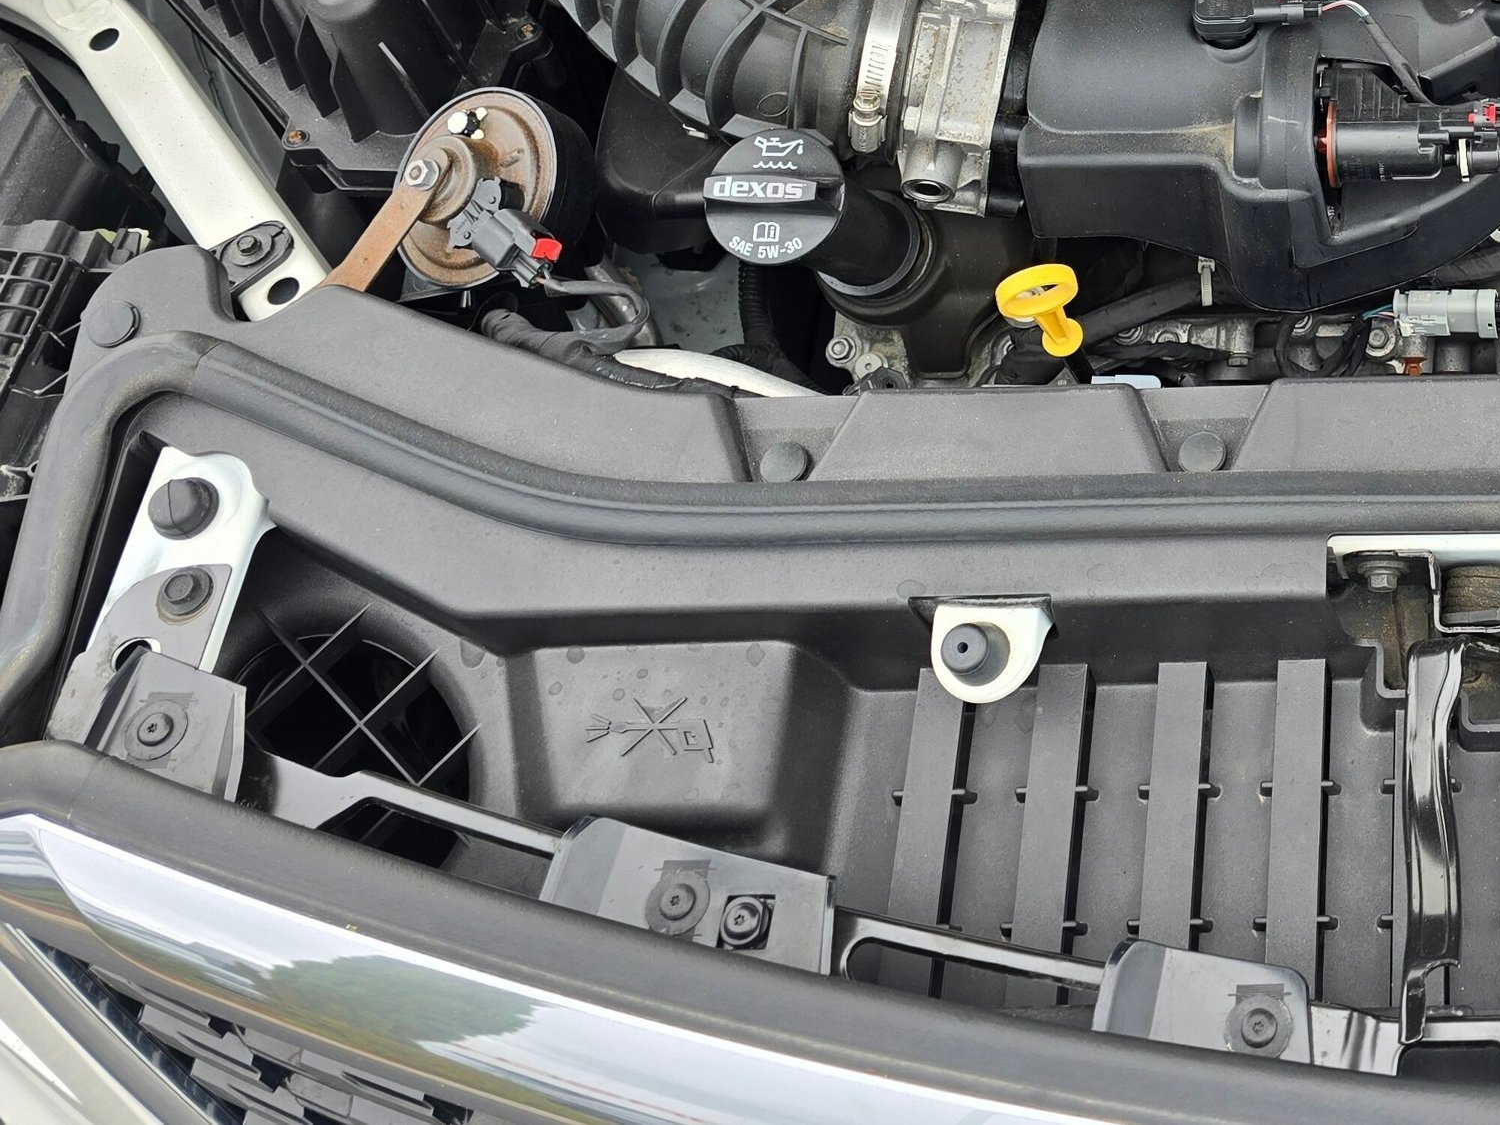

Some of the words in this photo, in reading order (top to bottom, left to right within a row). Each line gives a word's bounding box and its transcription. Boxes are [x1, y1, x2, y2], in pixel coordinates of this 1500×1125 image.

[713, 176, 806, 199] dexos
[729, 236, 753, 256] SAE
[758, 237, 802, 259] 5W-30
